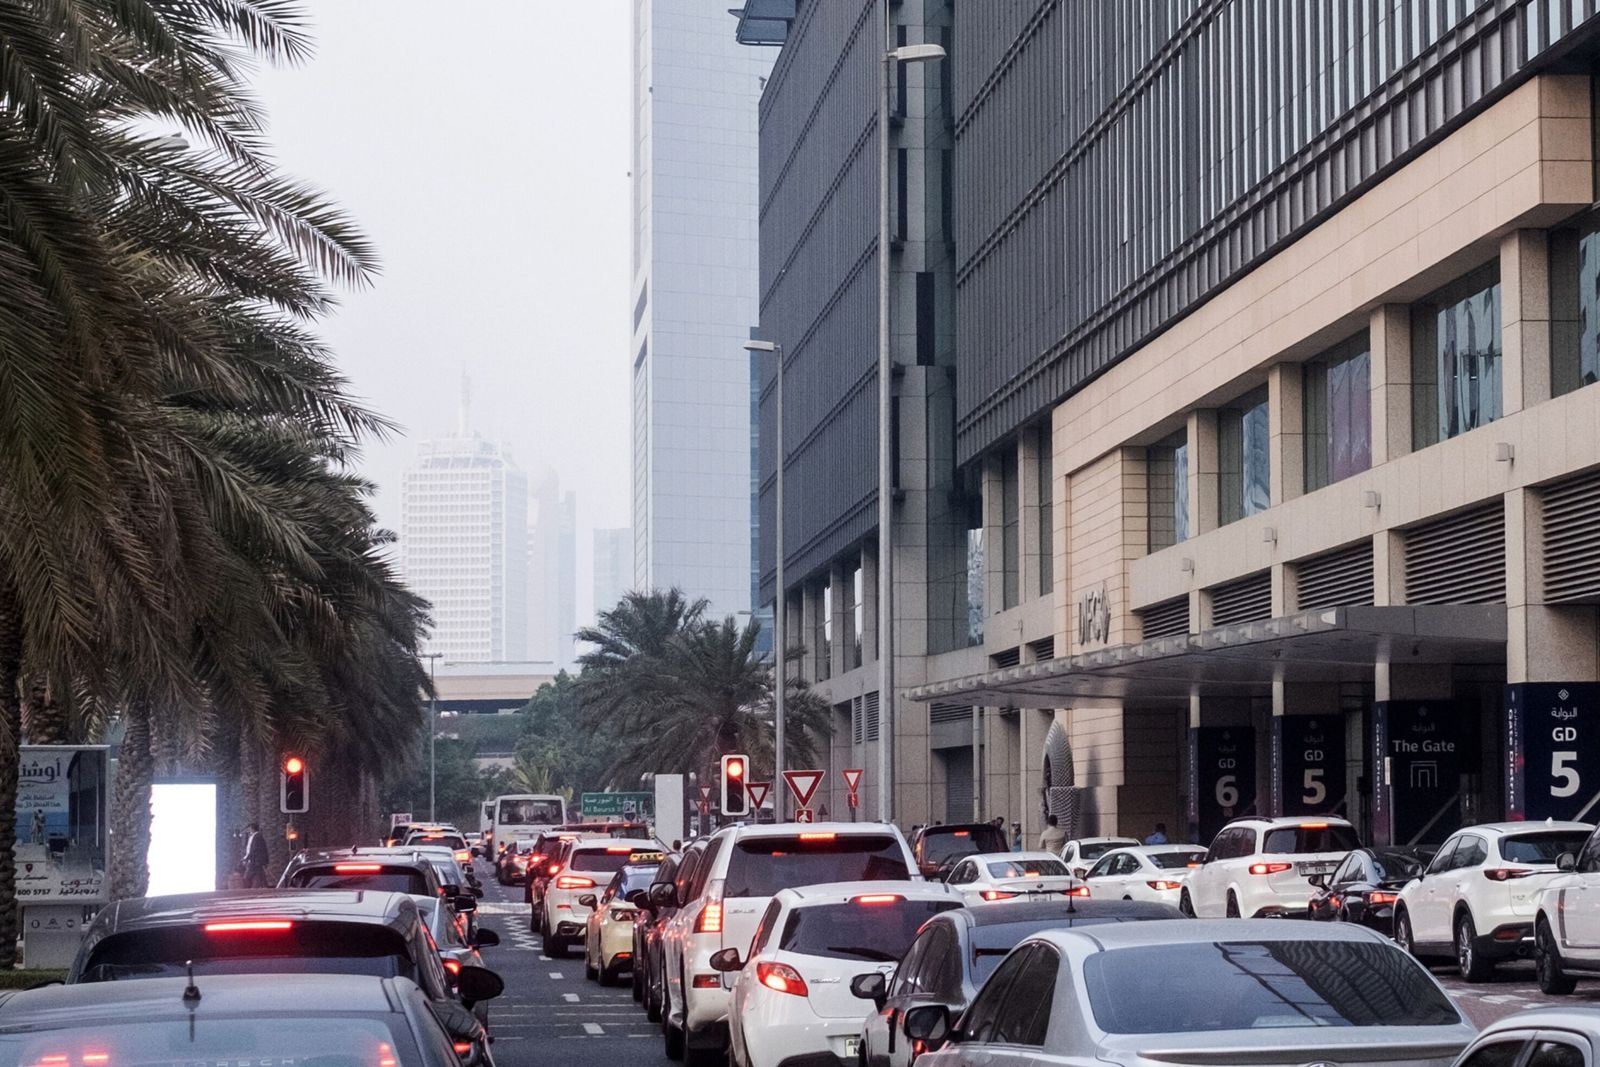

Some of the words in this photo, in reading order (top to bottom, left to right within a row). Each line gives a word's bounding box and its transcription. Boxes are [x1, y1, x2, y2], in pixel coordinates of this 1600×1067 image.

[1551, 707, 1578, 720] البوابة
[1552, 726, 1577, 742] GD
[1392, 739, 1419, 752] The
[1422, 739, 1455, 752] Gate
[1304, 749, 1324, 761] GD
[1218, 758, 1236, 769] GD
[1550, 751, 1581, 797] 5
[1215, 775, 1239, 807] 6
[1302, 768, 1327, 805] 5
